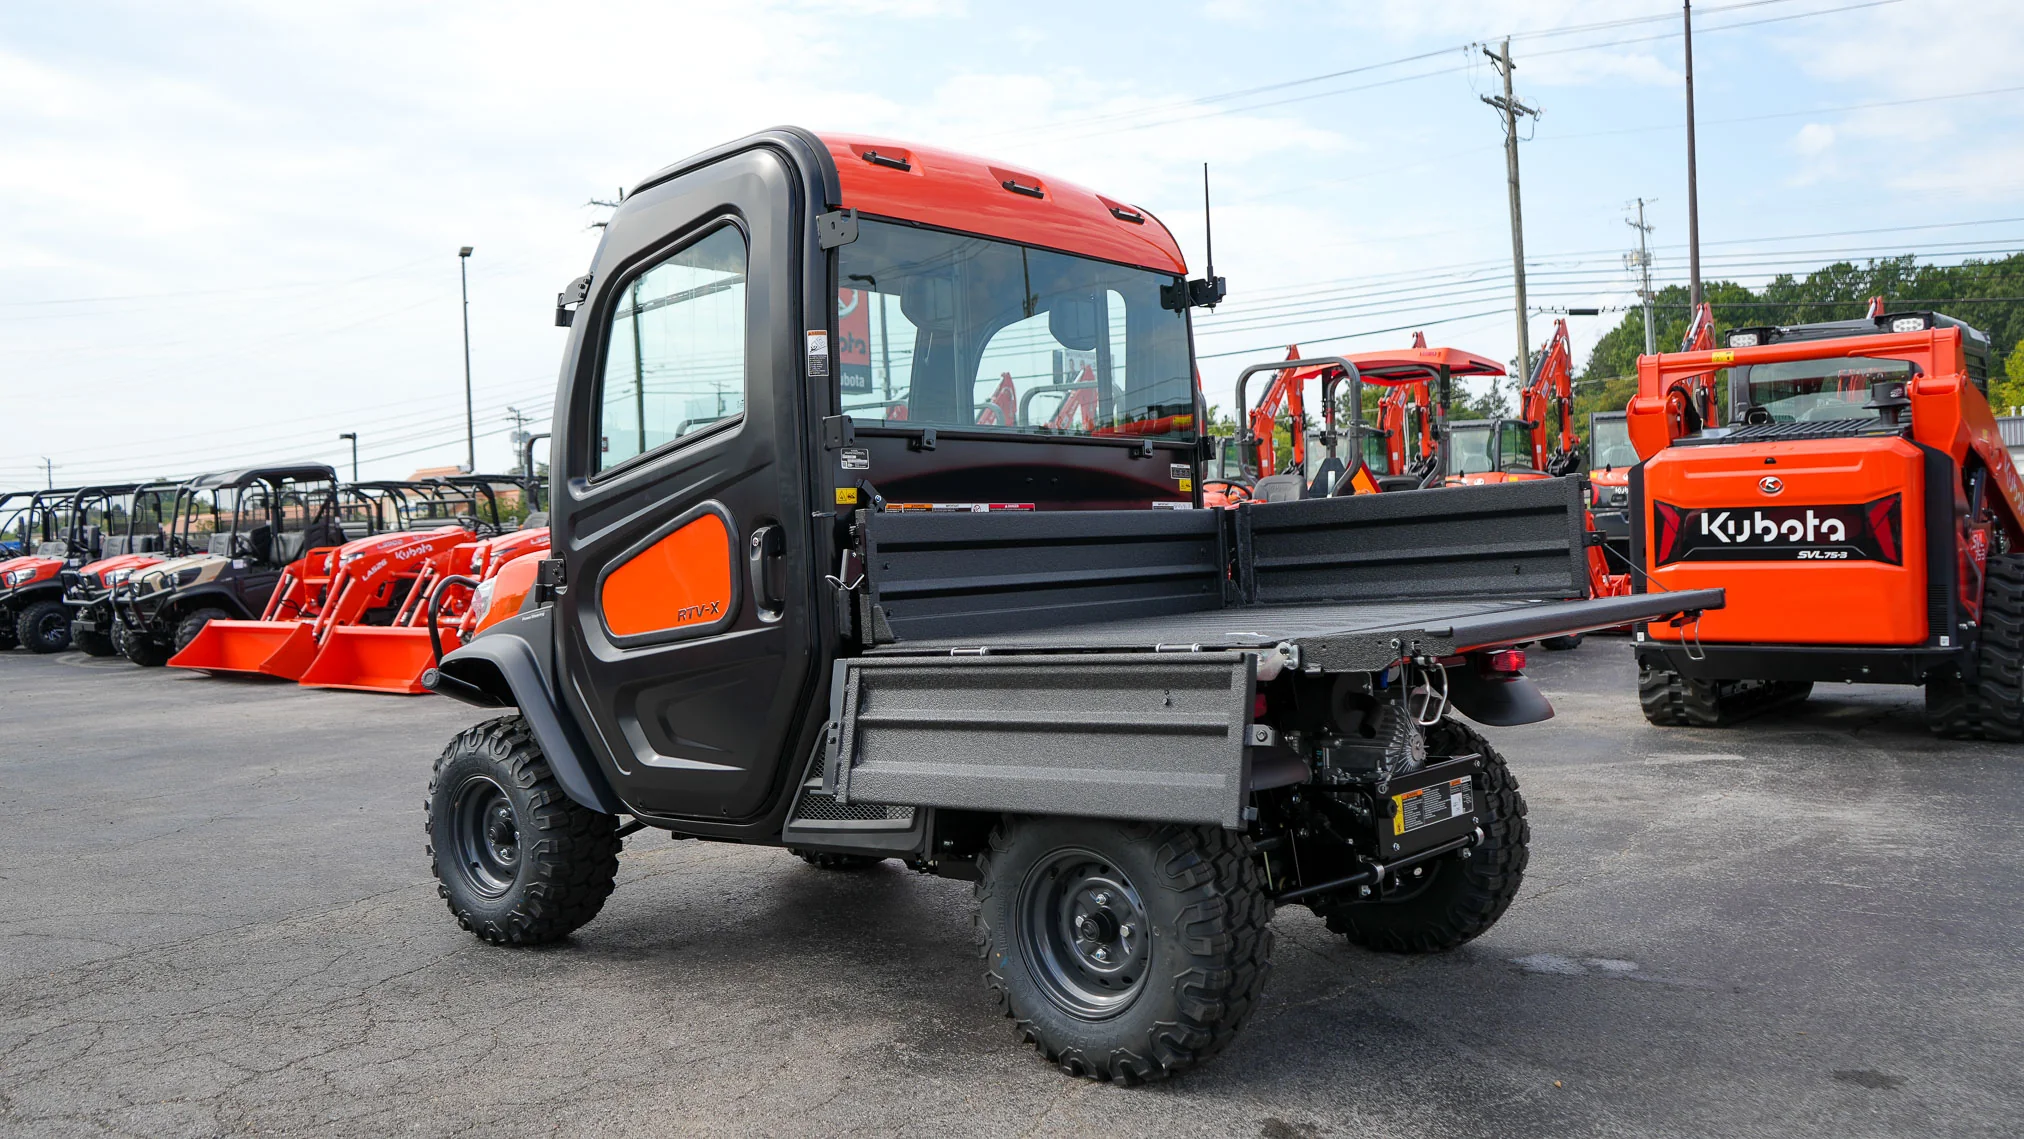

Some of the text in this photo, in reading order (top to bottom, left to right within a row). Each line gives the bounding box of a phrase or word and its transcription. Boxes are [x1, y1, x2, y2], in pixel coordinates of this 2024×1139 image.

[1701, 510, 1846, 543] Kubota
[395, 543, 433, 560] Kubota
[678, 600, 720, 622] RTV-X
